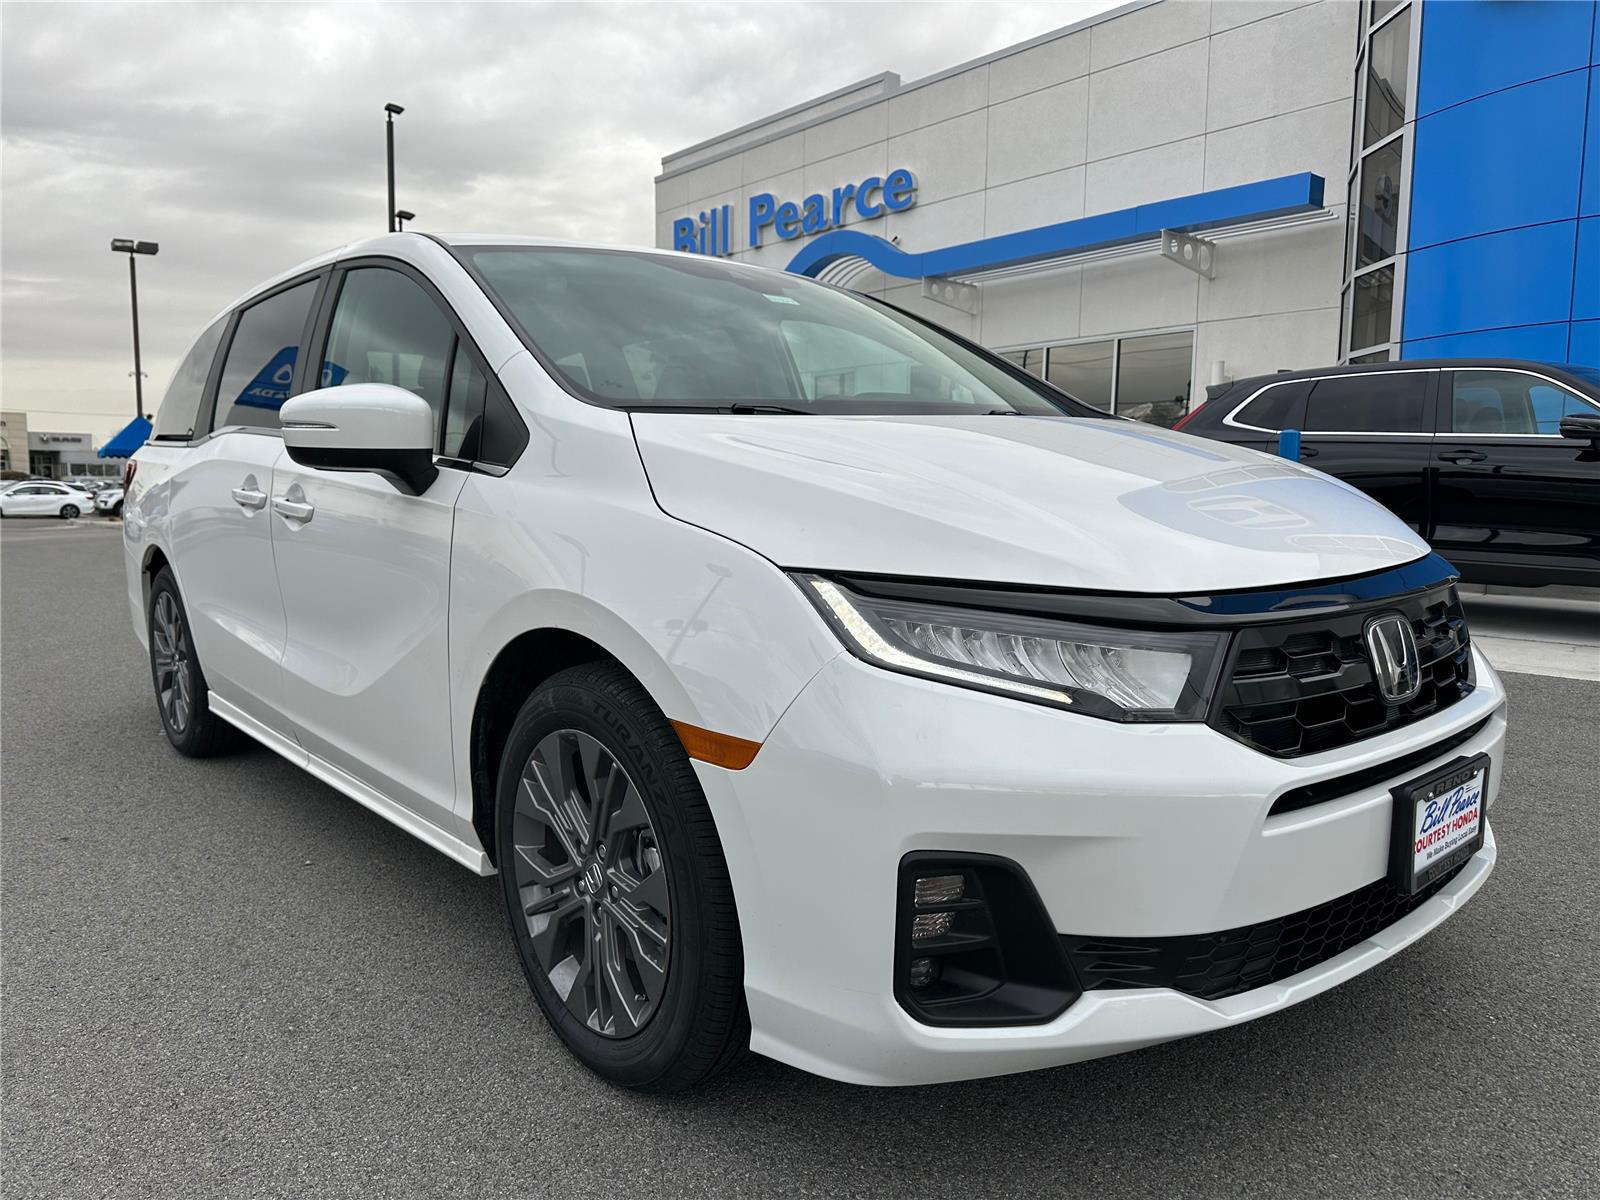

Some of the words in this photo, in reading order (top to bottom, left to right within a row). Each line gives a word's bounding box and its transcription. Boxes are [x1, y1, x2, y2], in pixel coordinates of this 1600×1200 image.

[673, 204, 732, 257] Bill
[749, 168, 914, 248] Pearce
[1435, 770, 1471, 794] RENO
[1419, 795, 1451, 835] Bill
[1448, 786, 1480, 819] Pearce
[1452, 808, 1479, 831] HONDA
